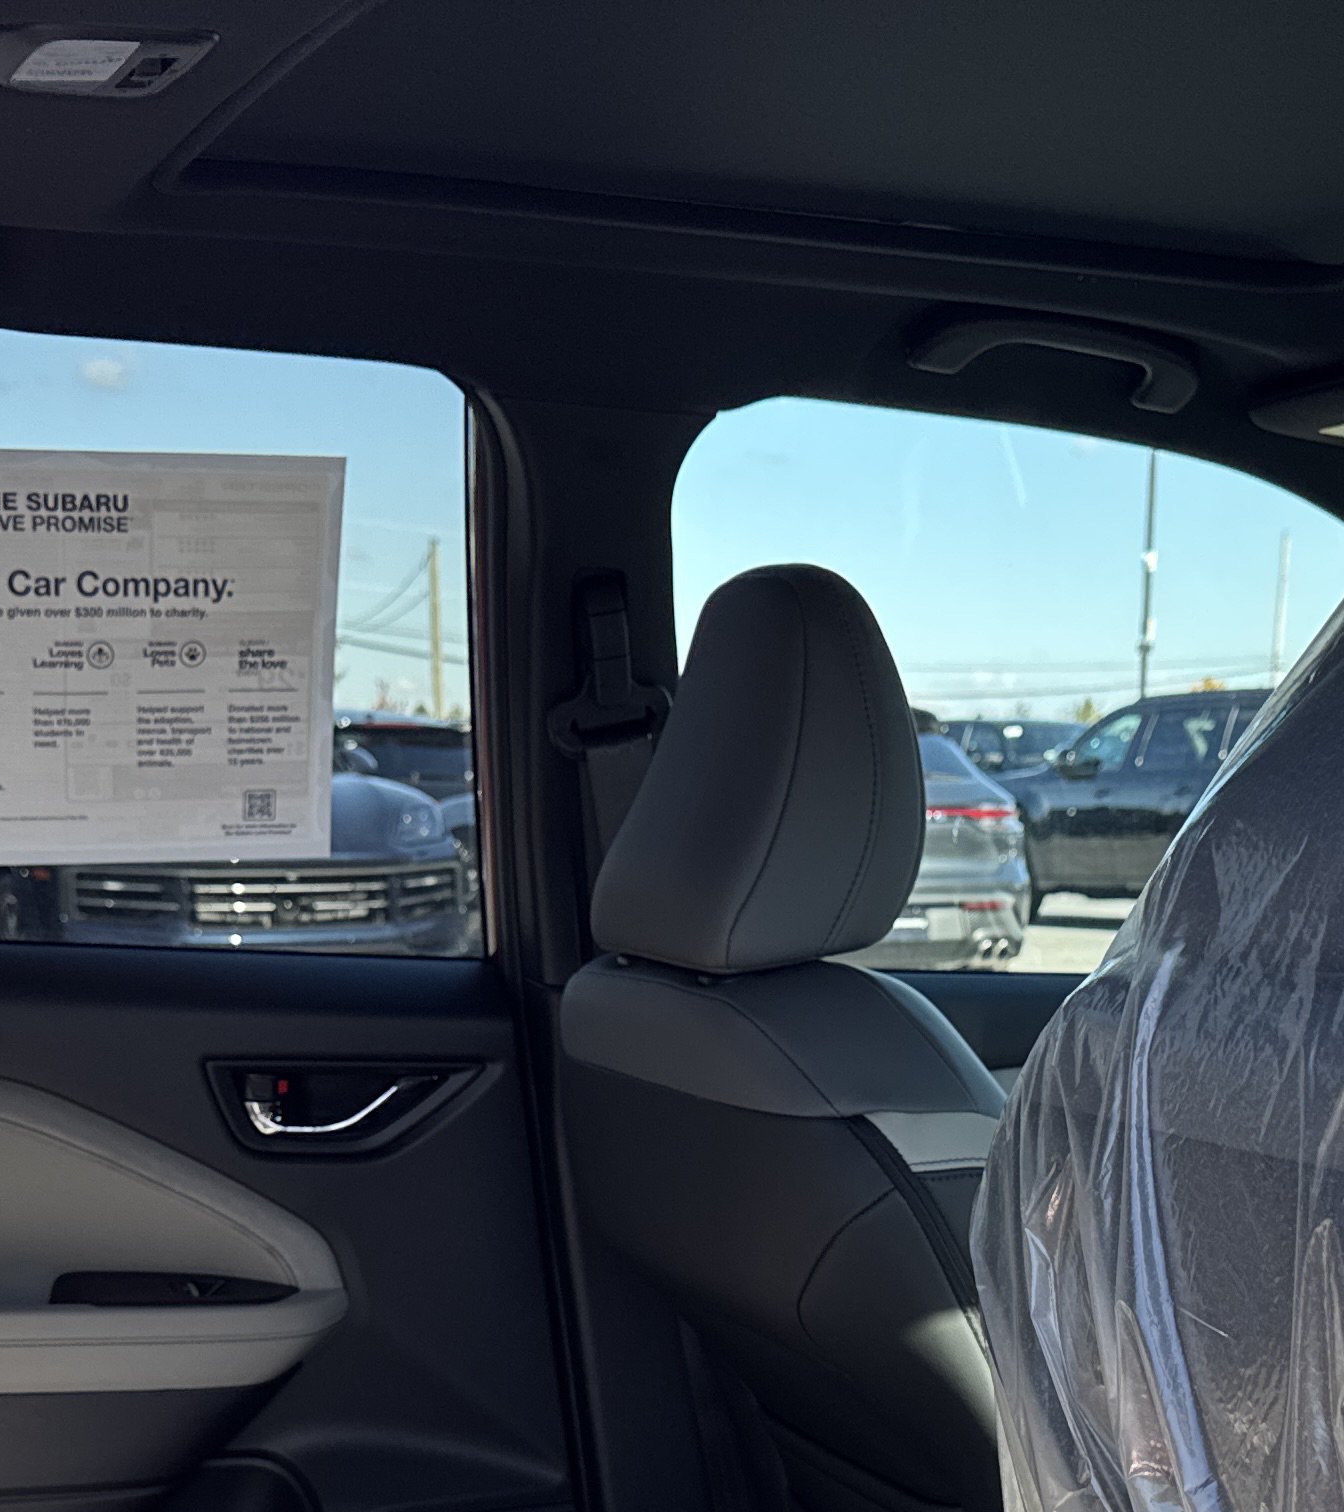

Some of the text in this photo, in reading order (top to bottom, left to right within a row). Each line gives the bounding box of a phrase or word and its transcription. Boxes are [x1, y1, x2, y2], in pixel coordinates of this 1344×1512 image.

[26, 493, 129, 513] SUBARU
[31, 515, 129, 533] PROMISE
[8, 570, 66, 598] Car
[75, 569, 234, 603] Company.
[8, 605, 40, 620] given
[43, 606, 72, 618] over
[74, 605, 103, 618] $300
[106, 605, 145, 618] million
[149, 606, 162, 618] to
[164, 605, 208, 620] charity.
[49, 648, 83, 657] Loves
[143, 649, 176, 658] Loves
[238, 648, 274, 658] share
[33, 659, 83, 670] Learning
[152, 658, 176, 667] Pets
[239, 659, 287, 669] the love
[33, 708, 66, 716] Helped
[137, 705, 204, 714] Helped support
[137, 716, 151, 724] the
[228, 715, 247, 723] than
[273, 715, 300, 723] million
[240, 726, 273, 734] national
[276, 726, 291, 734] and
[157, 737, 181, 745] health
[186, 737, 194, 745] of
[137, 749, 156, 757] over
[228, 747, 263, 755] charities
